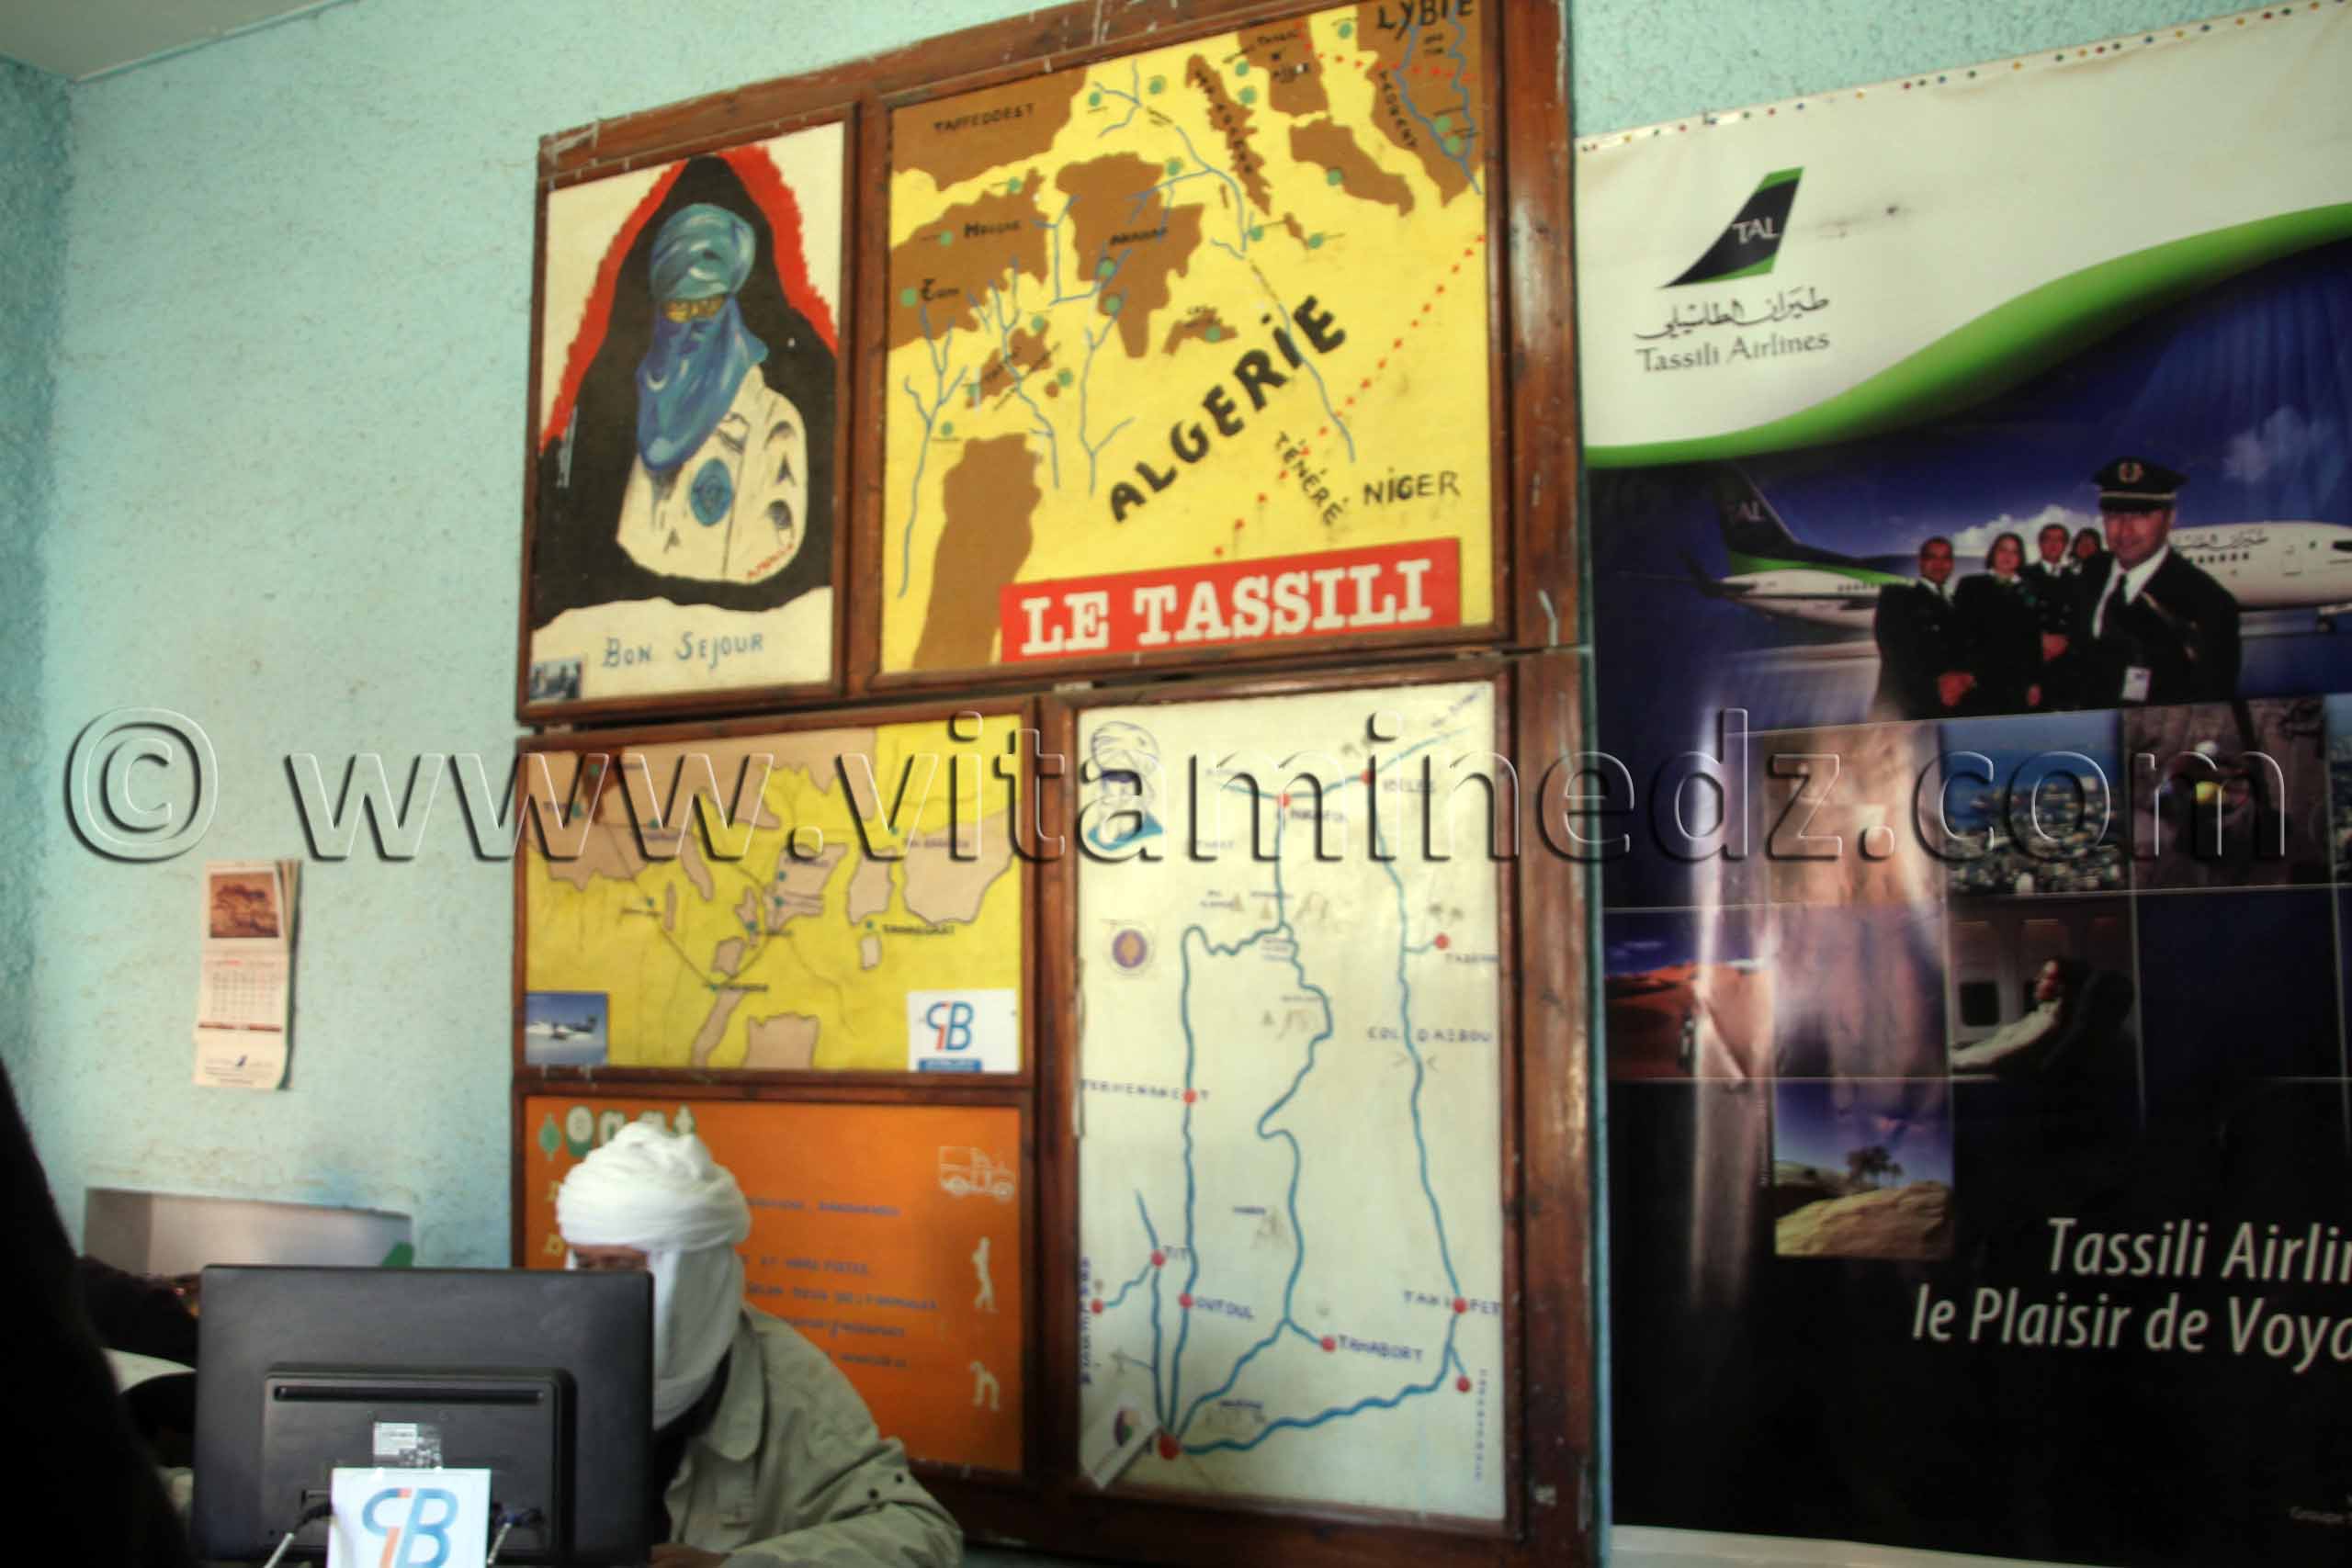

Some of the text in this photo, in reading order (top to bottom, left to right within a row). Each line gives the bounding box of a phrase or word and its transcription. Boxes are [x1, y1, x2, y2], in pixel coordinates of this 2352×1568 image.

[1732, 216, 1780, 244] TAL
[1635, 332, 1831, 372] Tassili Airlines
[1109, 296, 1346, 523] ALGERIE
[1363, 466, 1462, 506] NIGER
[1020, 558, 1432, 657] LE TASSILI
[602, 631, 764, 670] BON SEJOUR
[2048, 1217, 2209, 1277] Tassili
[1913, 1284, 1956, 1342] le
[1969, 1288, 2132, 1348] Plaisir
[2144, 1292, 2209, 1351] de
